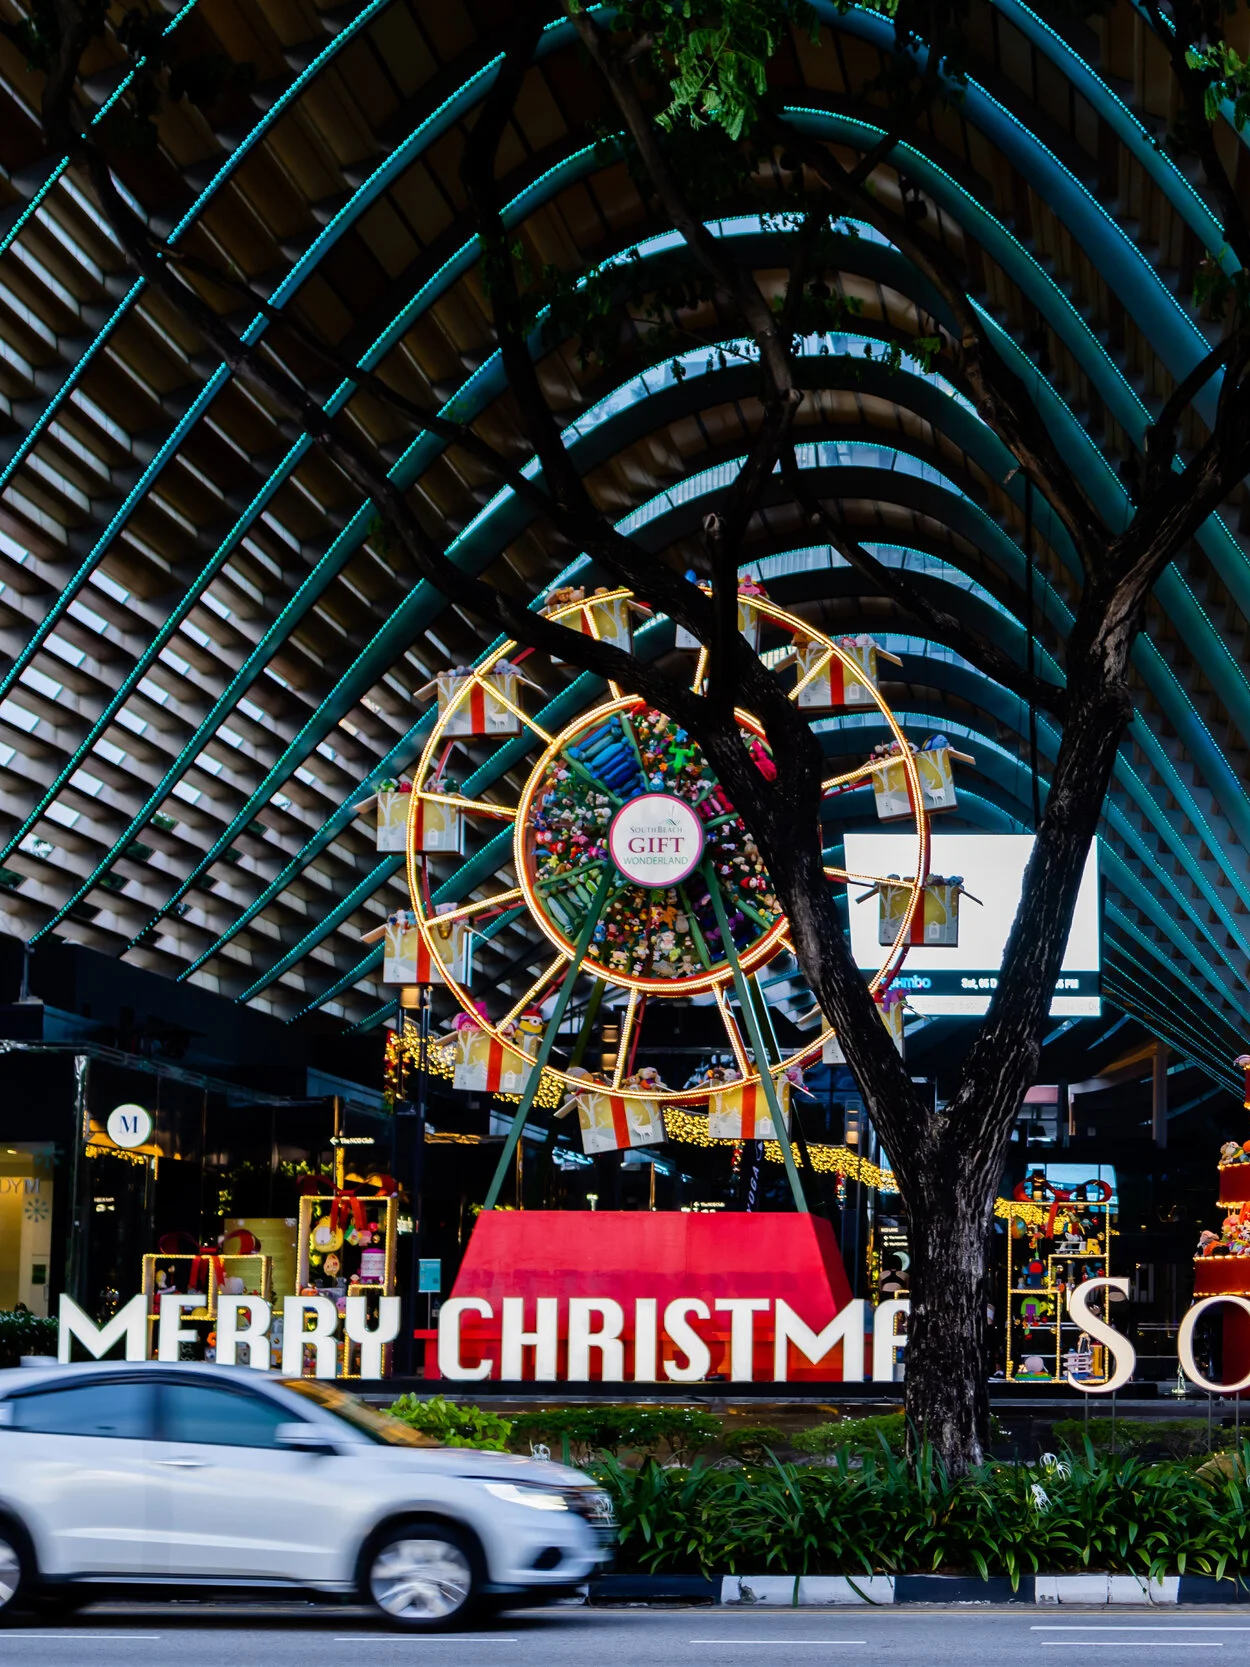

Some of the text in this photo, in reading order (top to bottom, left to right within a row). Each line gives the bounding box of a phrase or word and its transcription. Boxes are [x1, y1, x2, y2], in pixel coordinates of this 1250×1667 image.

[628, 837, 685, 854] GIFT
[623, 857, 689, 865] WONDERLAND
[119, 1115, 138, 1134] M
[437, 1297, 910, 1382] CHRISTMA
